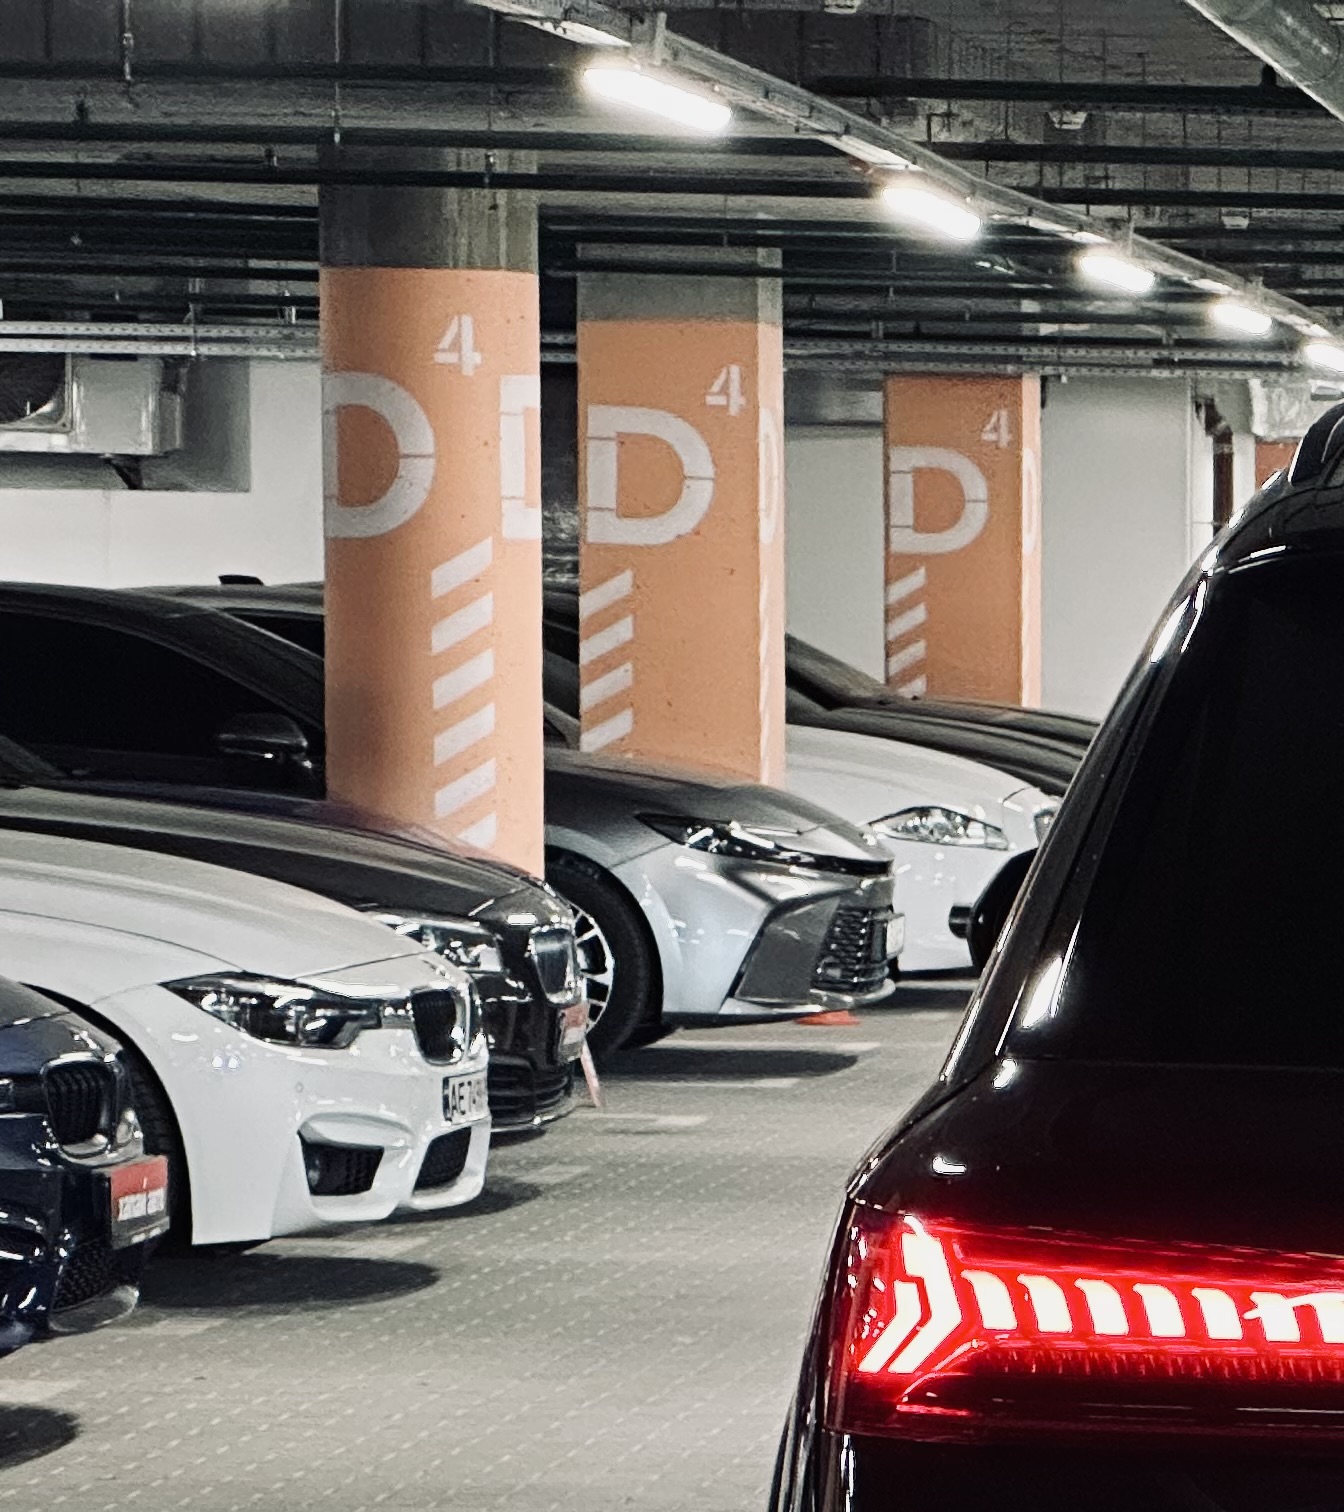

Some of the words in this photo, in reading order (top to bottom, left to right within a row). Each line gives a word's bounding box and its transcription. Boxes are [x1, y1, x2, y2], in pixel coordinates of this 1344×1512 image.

[434, 314, 482, 376] 4
[706, 364, 747, 417] 4
[981, 410, 1012, 449] 4
[322, 371, 436, 540] D
[586, 404, 716, 547] D
[888, 445, 990, 555] D
